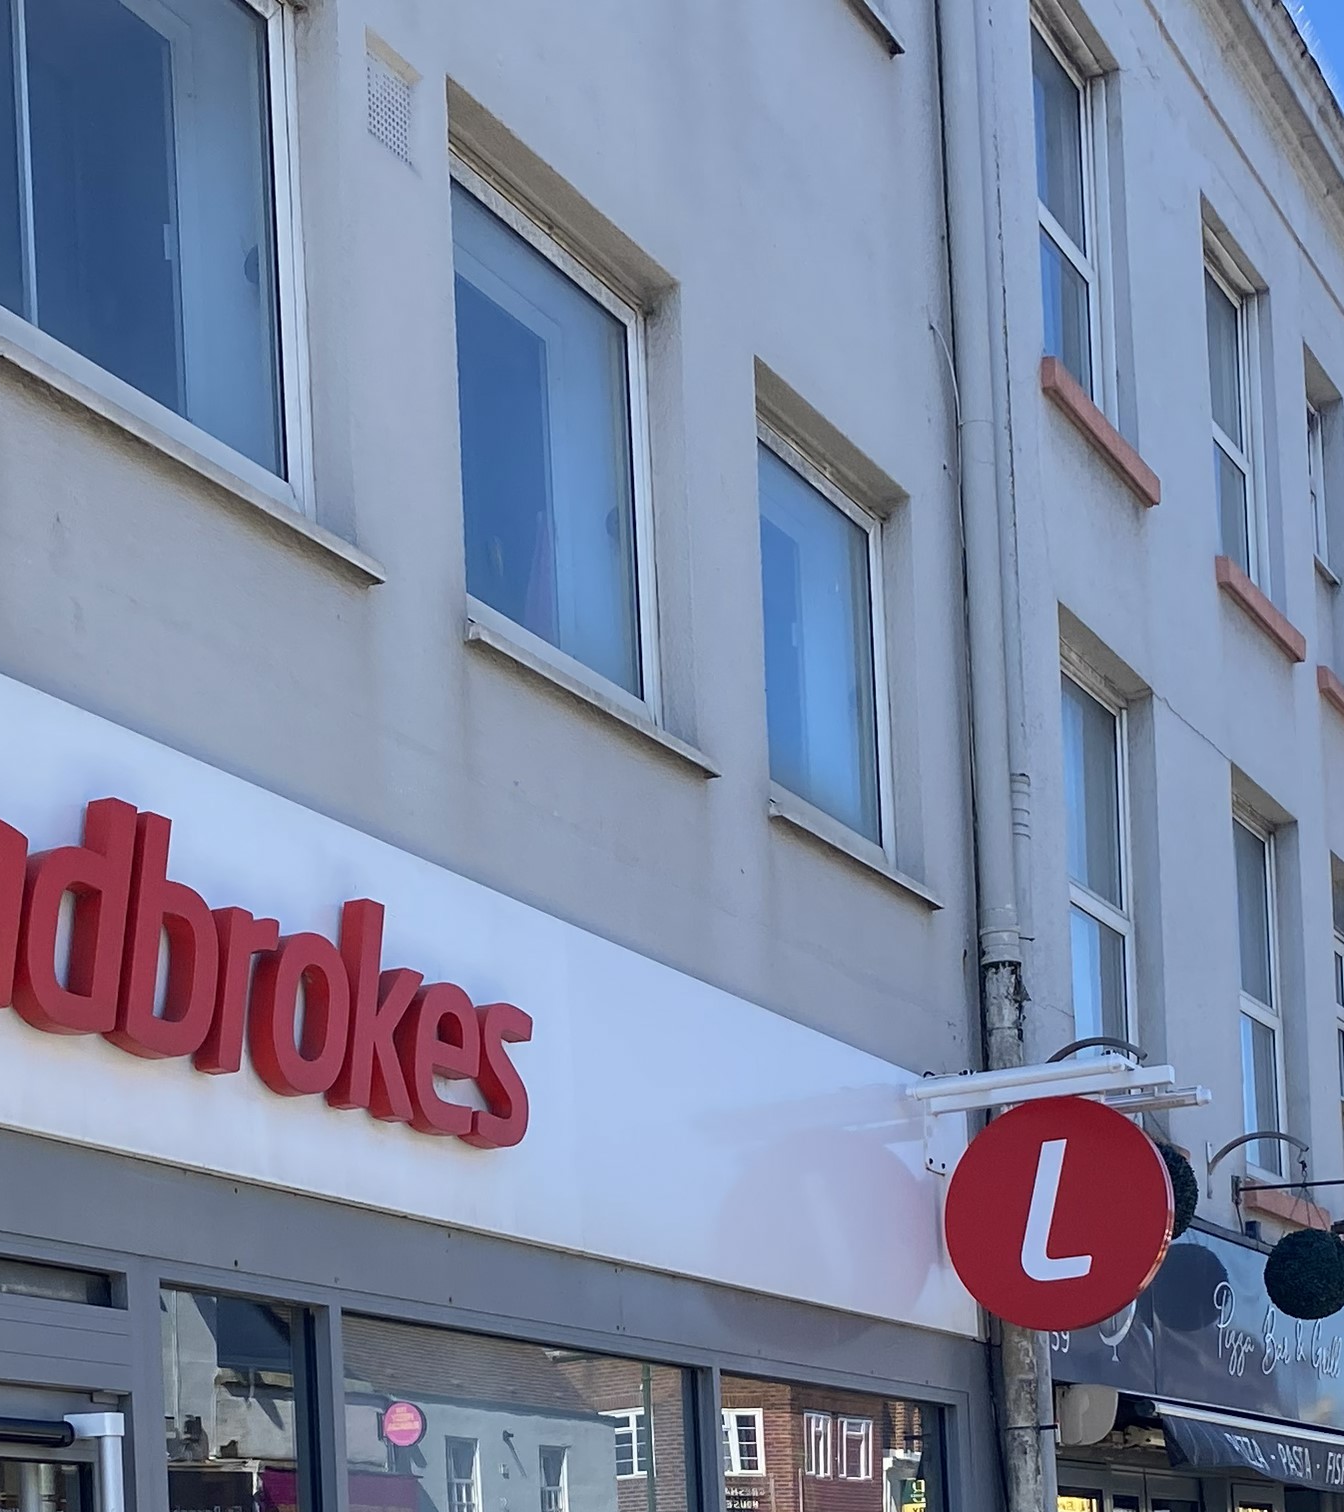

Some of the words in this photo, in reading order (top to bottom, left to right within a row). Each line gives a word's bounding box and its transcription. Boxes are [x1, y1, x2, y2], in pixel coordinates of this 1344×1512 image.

[1020, 1138, 1093, 1282] L
[1213, 1280, 1255, 1377] Pizza
[1310, 1320, 1343, 1380] Grill
[1223, 1432, 1271, 1471] PIZZA
[1277, 1442, 1312, 1480] PASTA
